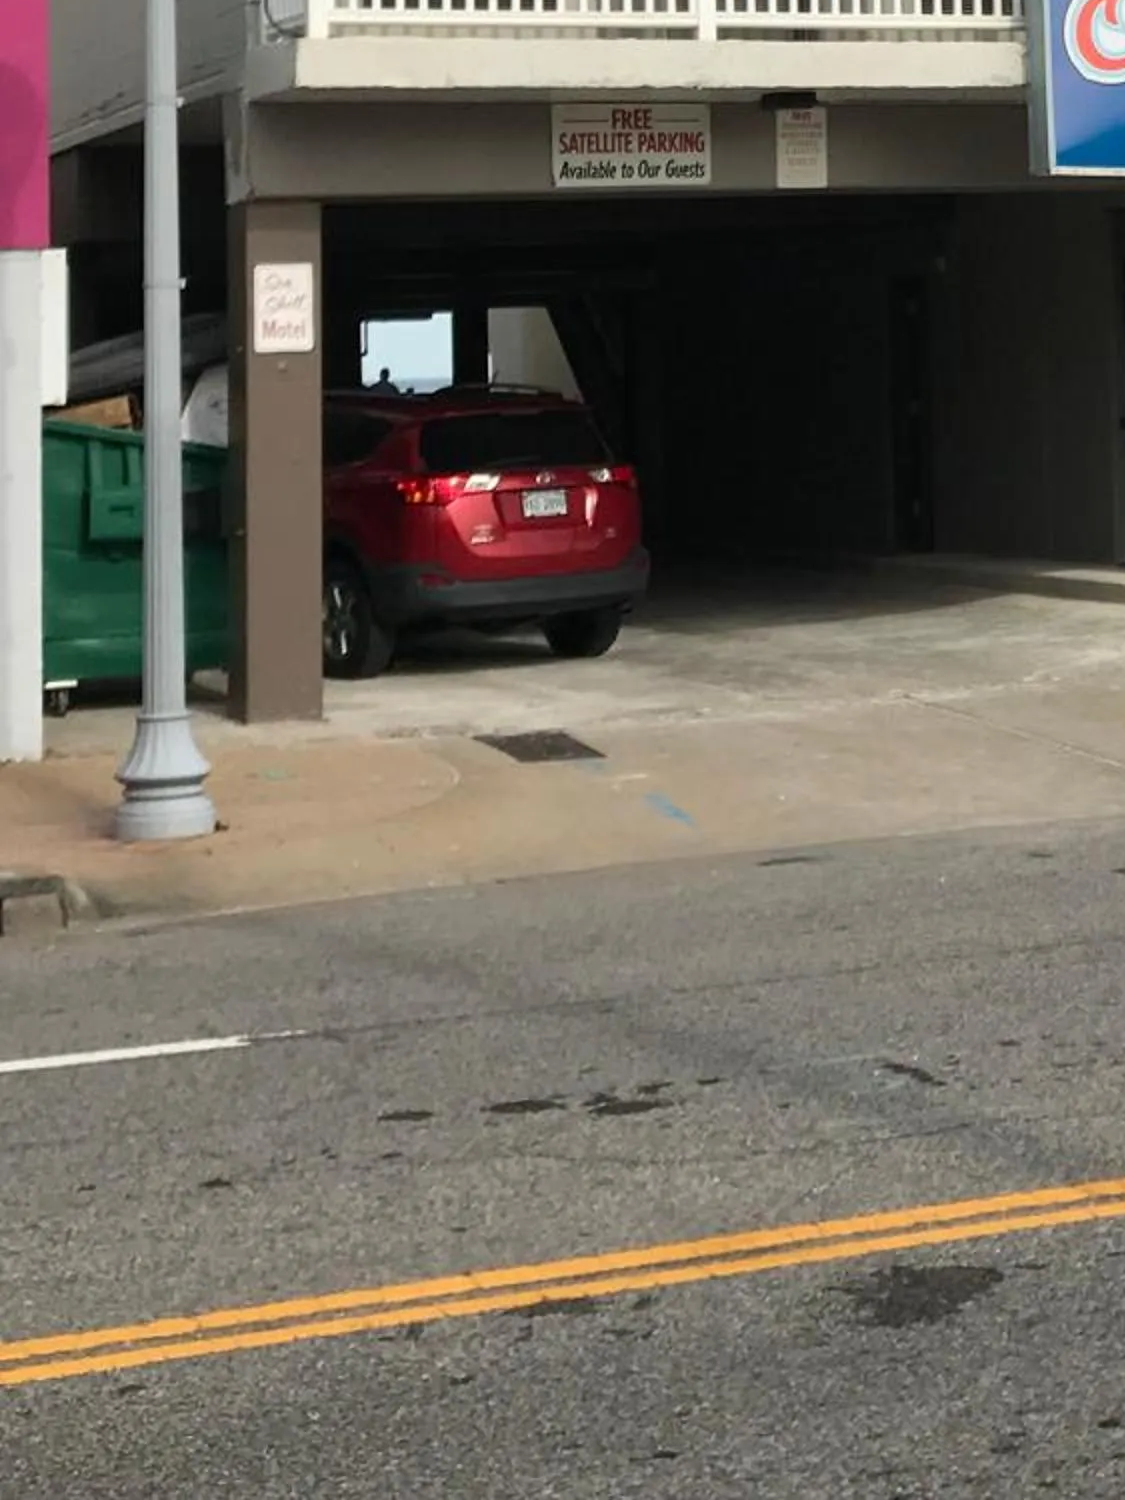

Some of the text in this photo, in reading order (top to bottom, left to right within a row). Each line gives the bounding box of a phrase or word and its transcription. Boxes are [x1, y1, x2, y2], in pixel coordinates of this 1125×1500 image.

[611, 108, 654, 130] FREE
[559, 131, 705, 155] SATELLITE PARKING
[559, 159, 705, 180] Available to Our Guests
[261, 319, 306, 341] Motel
